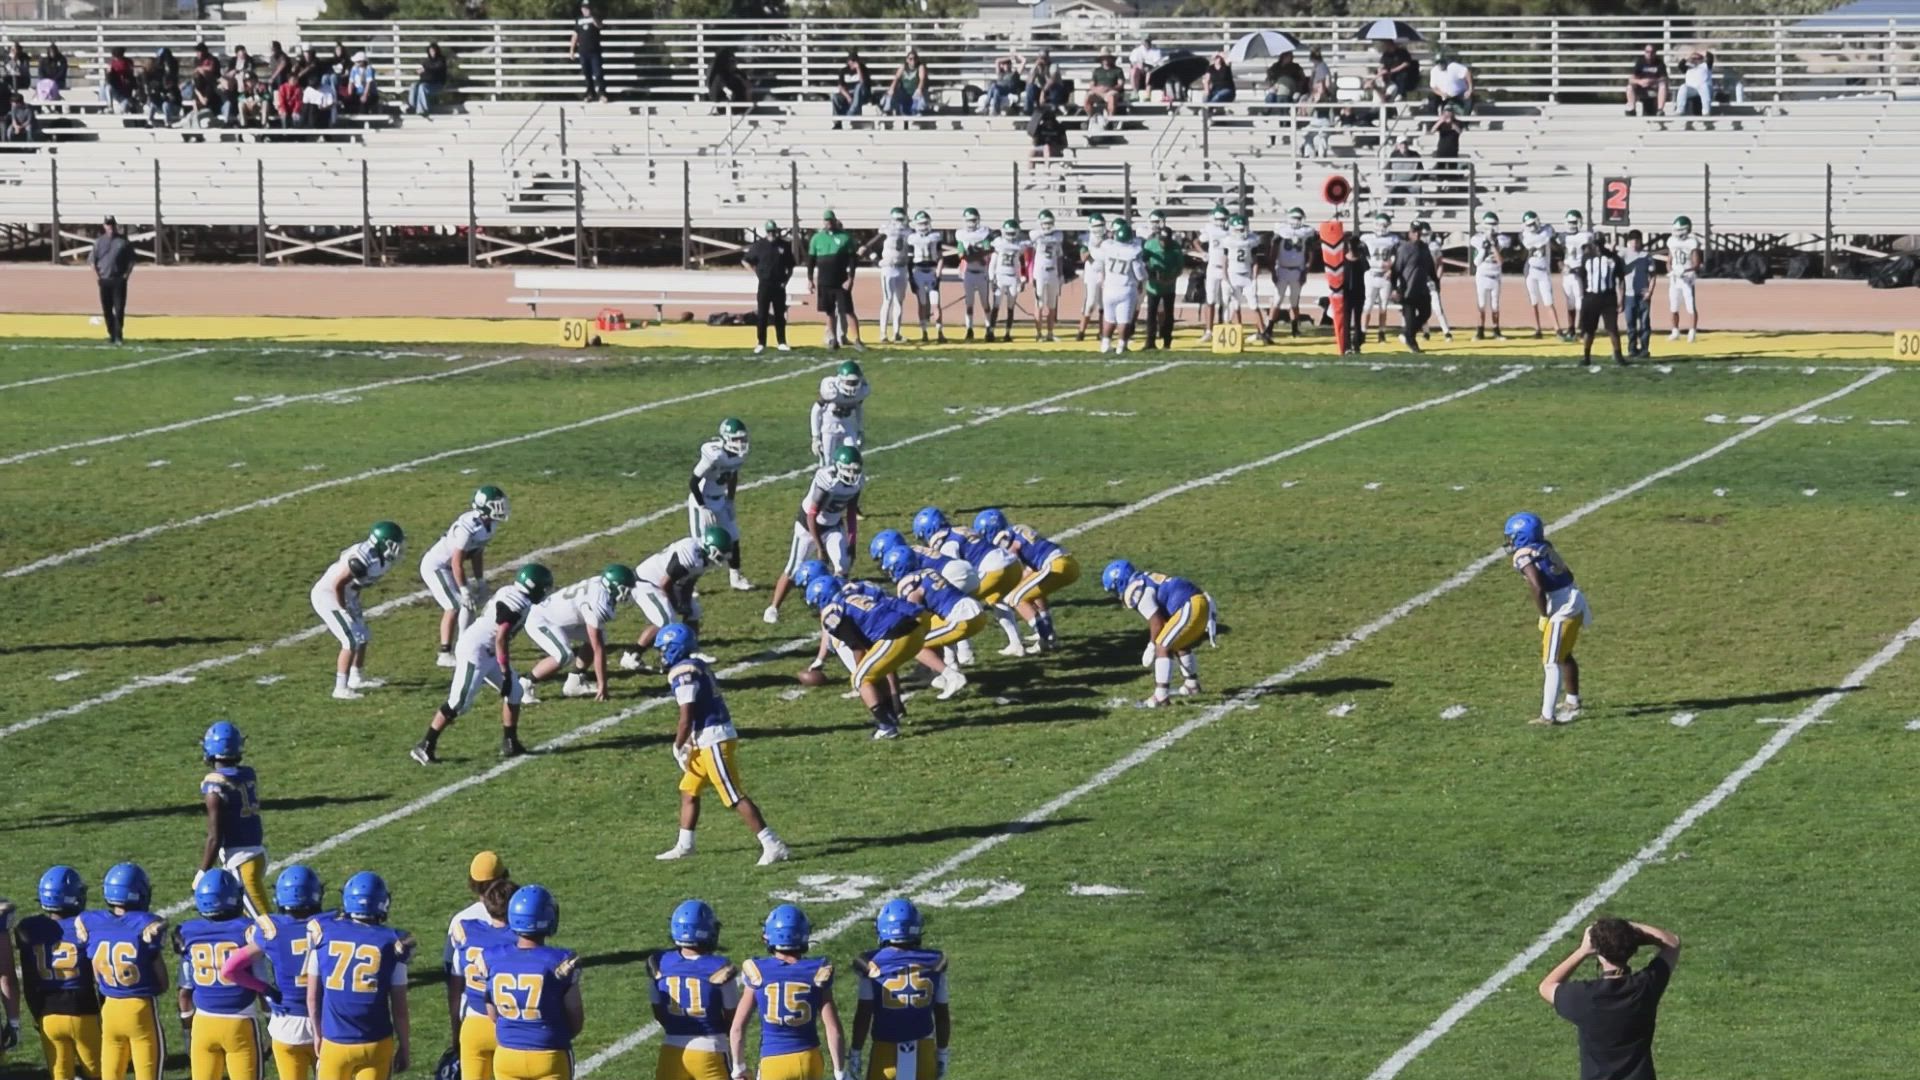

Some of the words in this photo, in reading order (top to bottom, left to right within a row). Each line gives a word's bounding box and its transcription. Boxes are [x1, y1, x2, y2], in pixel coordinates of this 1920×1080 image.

[1607, 181, 1628, 209] 2
[1108, 258, 1127, 275] 77
[1236, 249, 1246, 262] 2
[564, 321, 582, 341] 50
[1217, 328, 1238, 348] 40
[1899, 334, 1920, 355] 30
[33, 941, 80, 980] 12
[92, 941, 140, 987] 46
[191, 942, 240, 986] 80
[326, 940, 382, 992] 72
[493, 973, 544, 1020] 67
[665, 976, 708, 1017] 11
[763, 982, 812, 1026] 15
[881, 964, 935, 1010] 25
